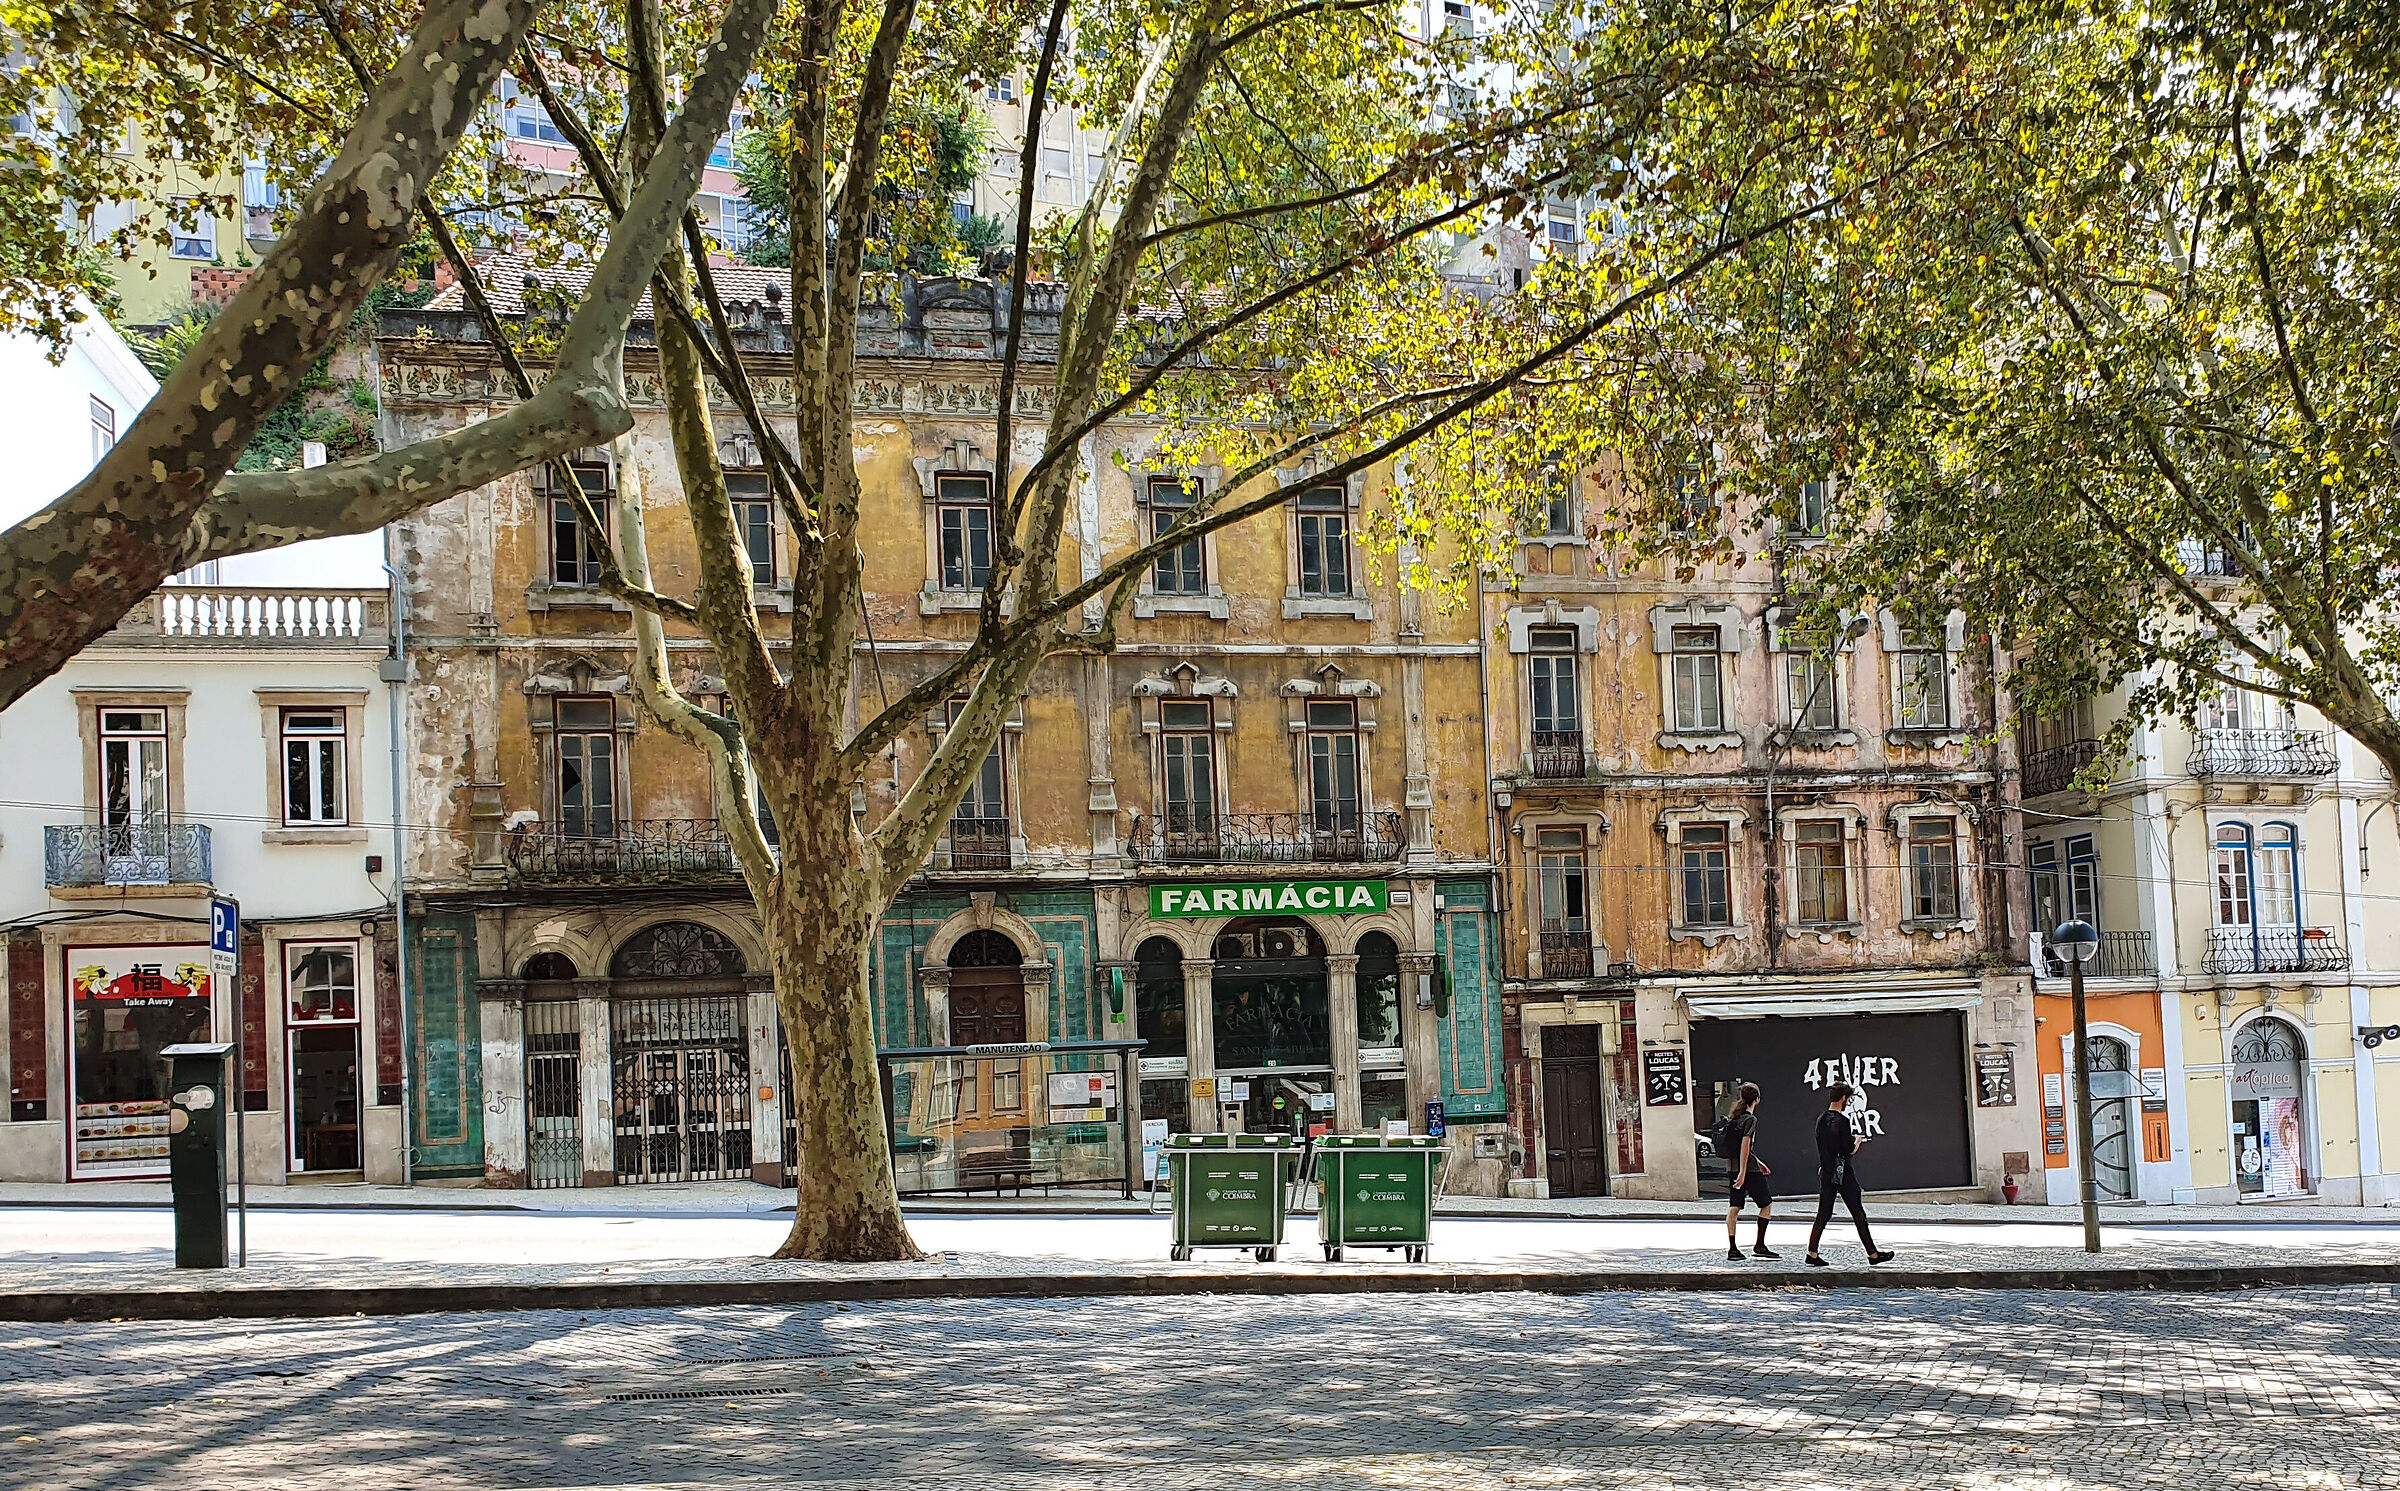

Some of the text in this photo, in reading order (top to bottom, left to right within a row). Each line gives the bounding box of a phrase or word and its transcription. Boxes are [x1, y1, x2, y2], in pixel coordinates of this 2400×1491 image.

[1161, 884, 1376, 912] FARMÁCIA
[213, 906, 225, 945] P
[124, 997, 174, 1007] Take Away
[1231, 1046, 1268, 1056] SANT
[1849, 1109, 1886, 1137] AR
[1222, 1192, 1257, 1200] COIMBRA
